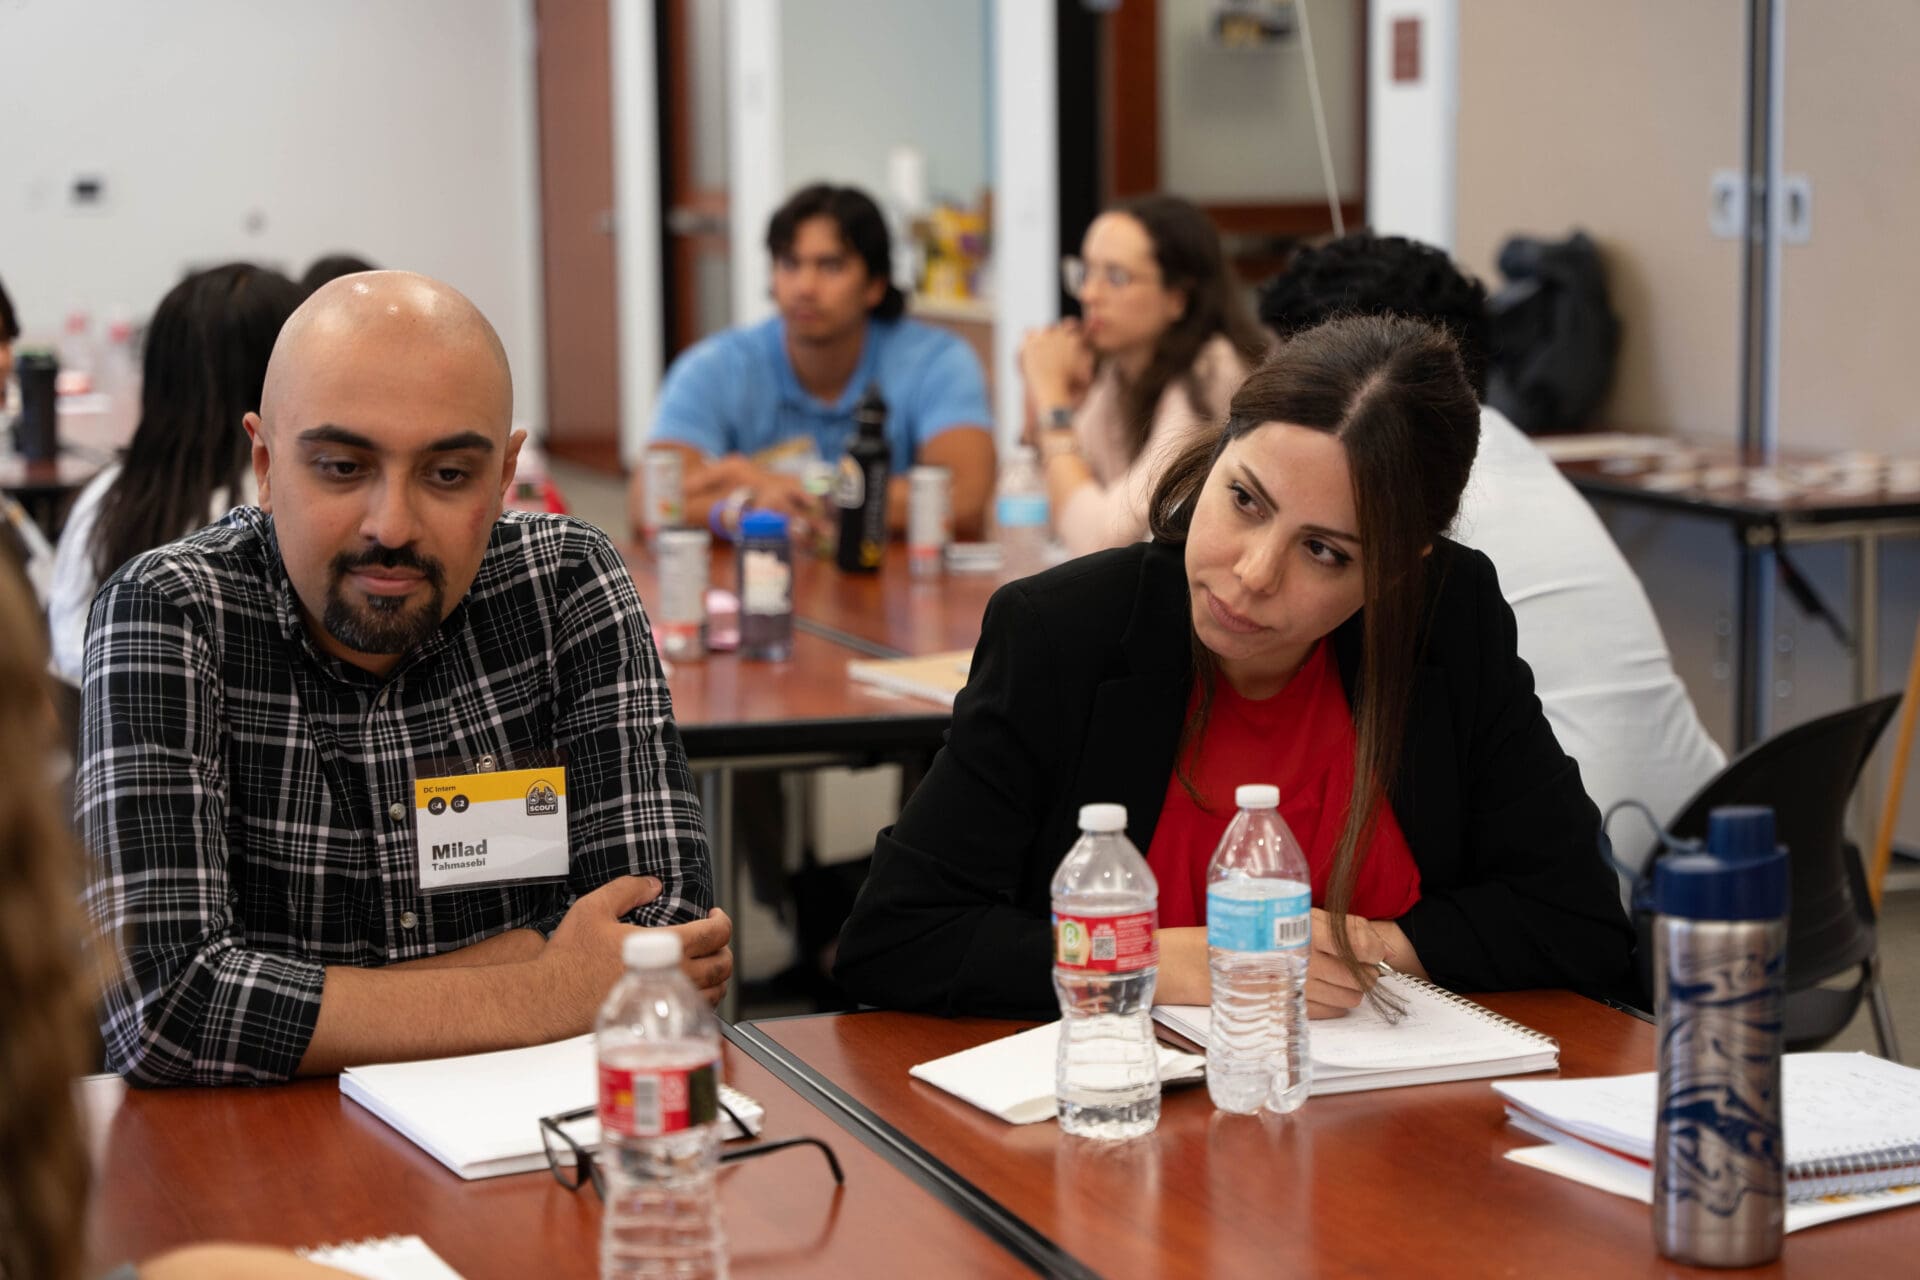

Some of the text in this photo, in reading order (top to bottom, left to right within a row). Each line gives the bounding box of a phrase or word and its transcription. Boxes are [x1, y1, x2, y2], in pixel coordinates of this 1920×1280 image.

[529, 804, 555, 812] SCOUT
[432, 839, 488, 860] Milad
[431, 858, 486, 871] Tahmasebi
